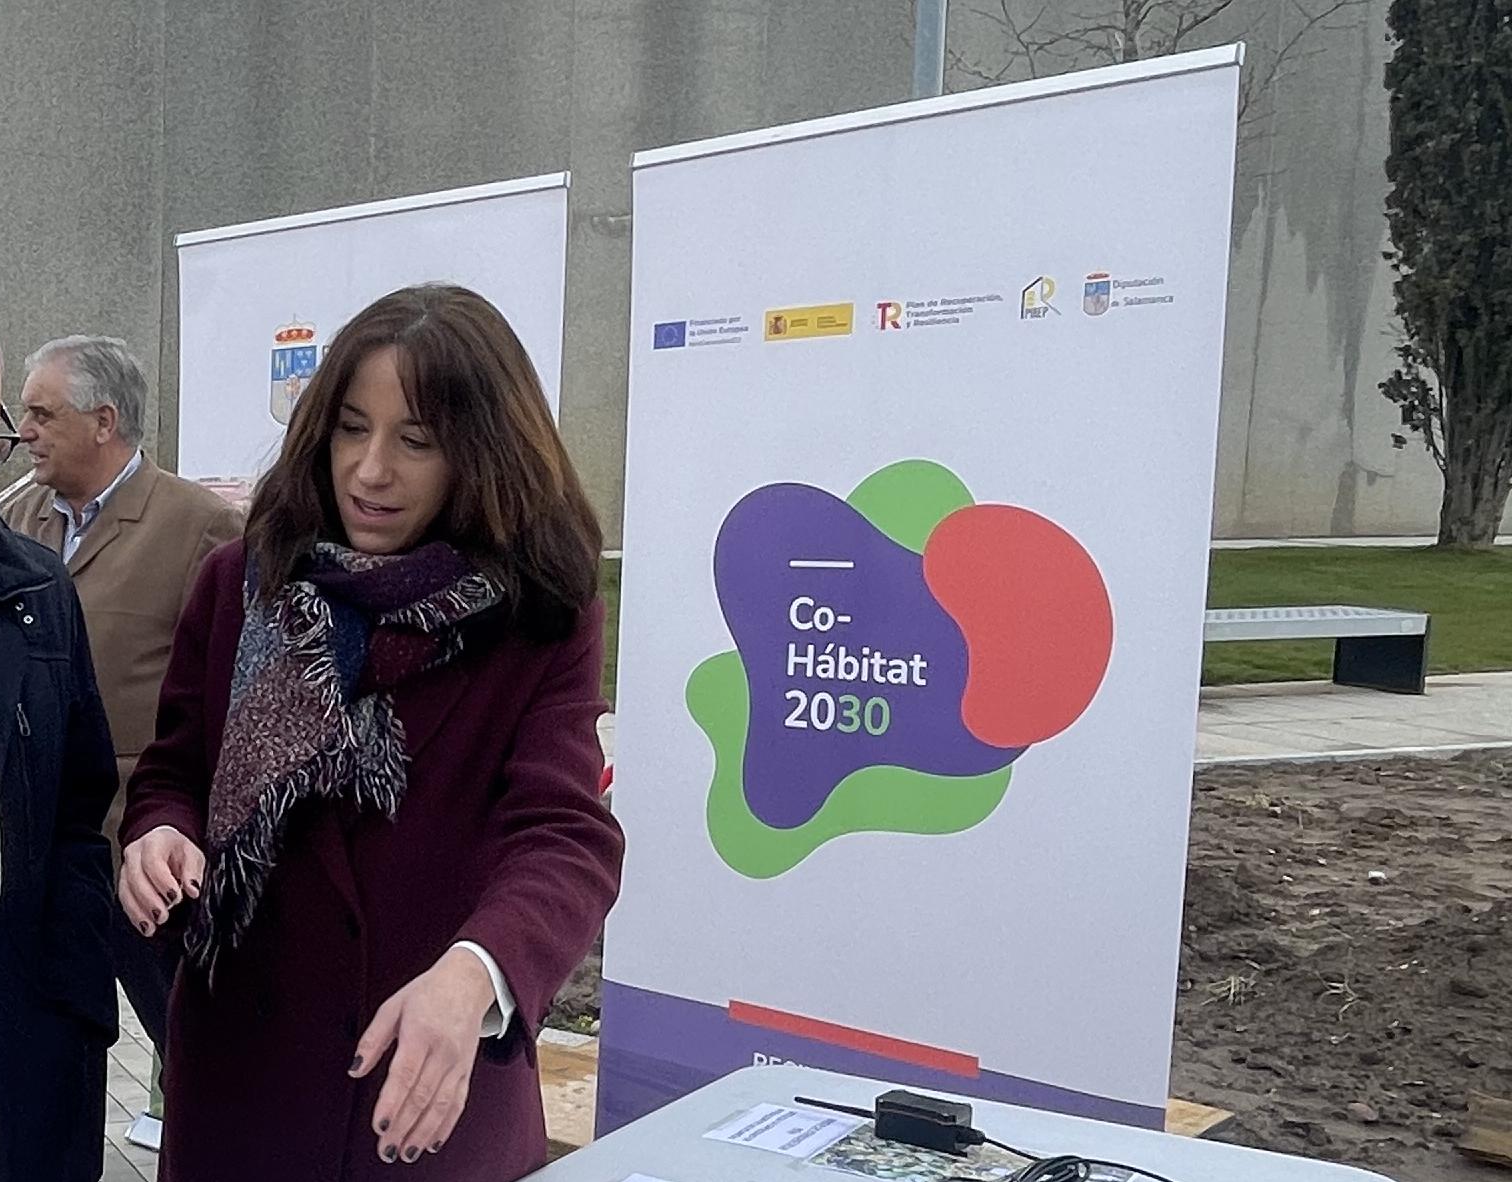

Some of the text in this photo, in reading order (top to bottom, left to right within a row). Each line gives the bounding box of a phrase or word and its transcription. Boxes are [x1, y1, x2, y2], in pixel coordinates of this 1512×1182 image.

[1124, 296, 1174, 307] Salamanca
[789, 596, 852, 632] Co-
[786, 643, 928, 687] Hábitat
[784, 690, 890, 736] 2030
